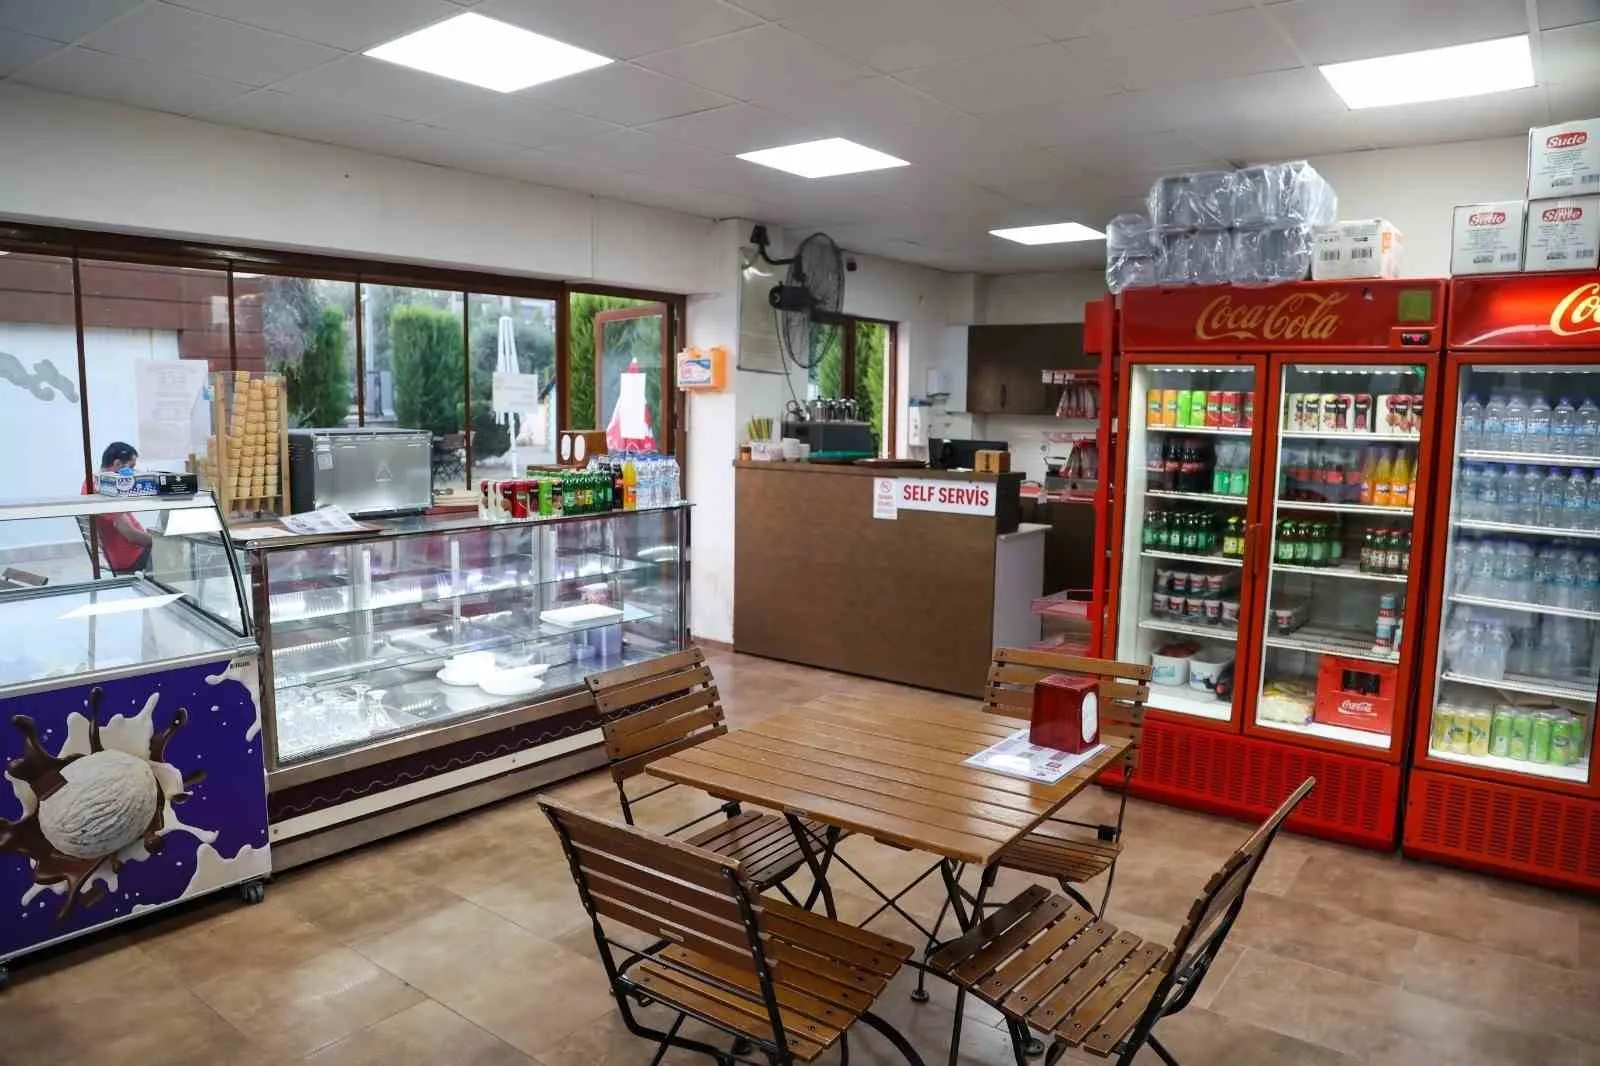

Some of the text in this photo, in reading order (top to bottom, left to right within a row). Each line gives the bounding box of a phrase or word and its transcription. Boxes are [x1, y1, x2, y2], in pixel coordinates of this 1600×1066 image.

[1548, 134, 1587, 147] Sude
[1196, 292, 1349, 340] Coca-Cola
[903, 484, 990, 507] SELF SERVİS
